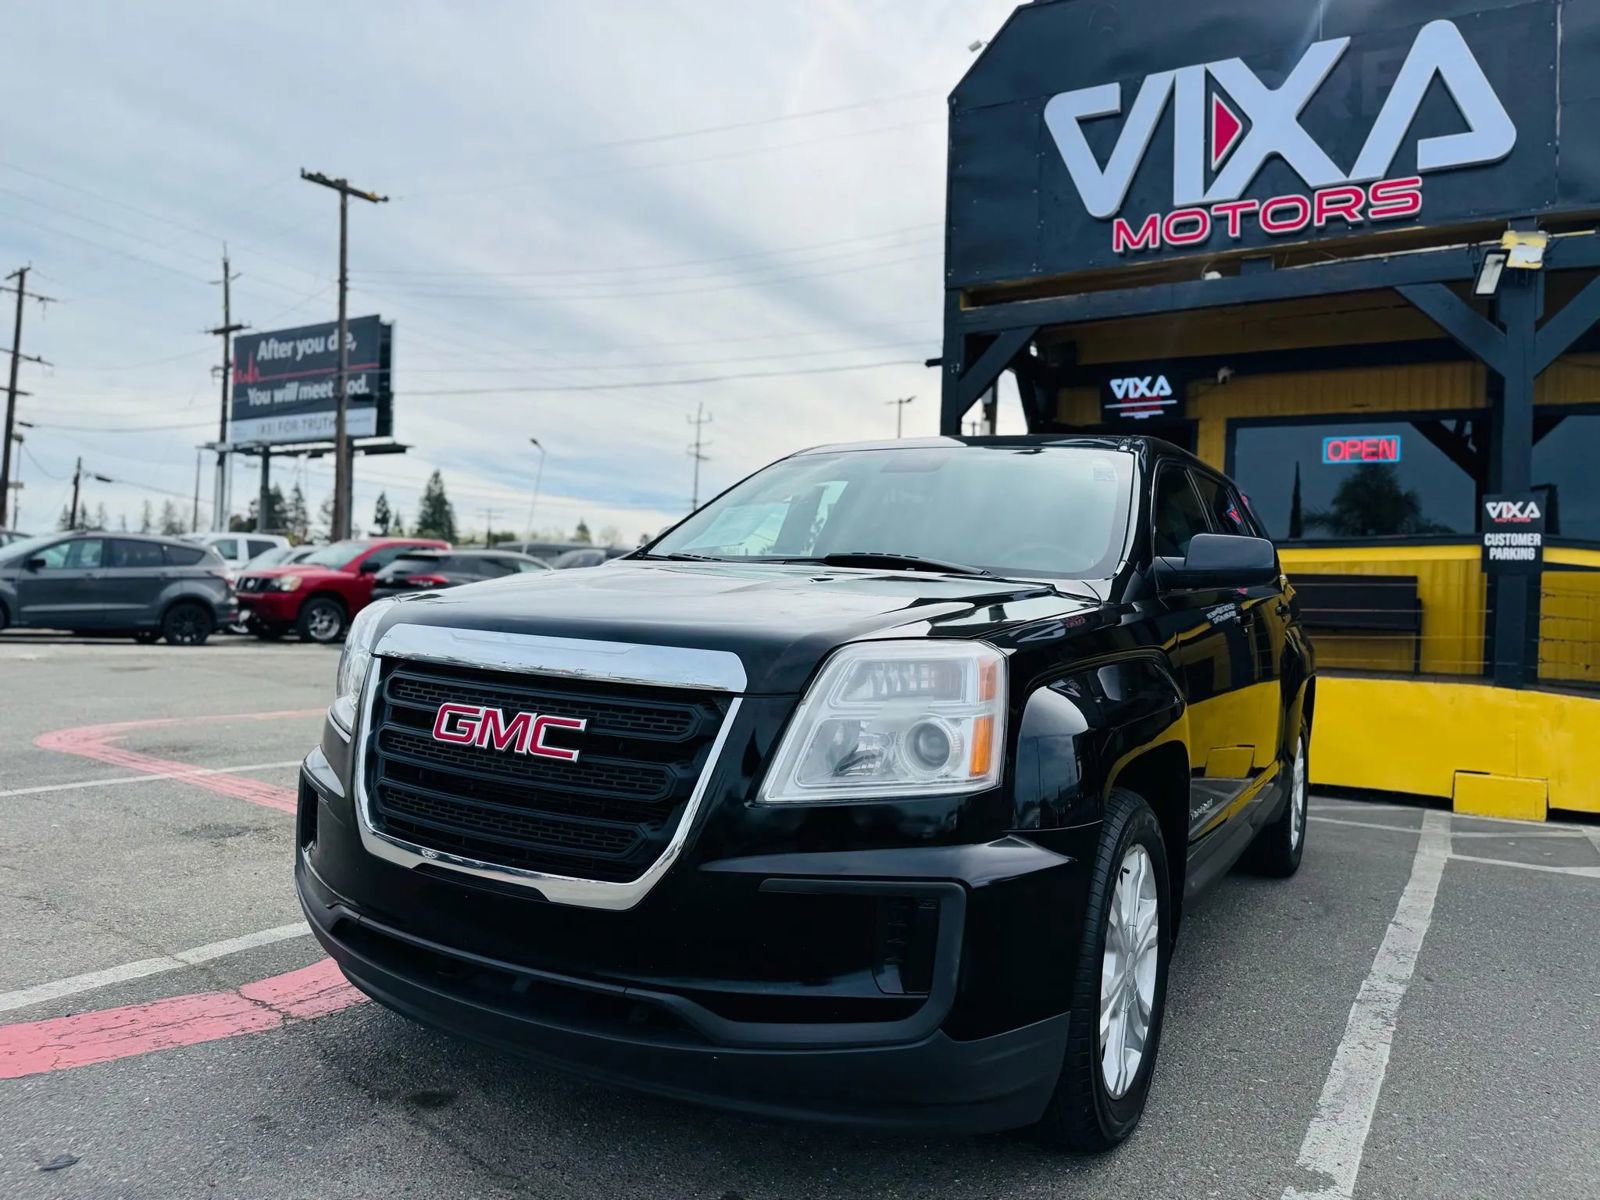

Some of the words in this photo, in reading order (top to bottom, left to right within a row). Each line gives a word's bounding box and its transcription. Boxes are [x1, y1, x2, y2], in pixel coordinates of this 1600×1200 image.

[1044, 19, 1517, 219] VIXA
[1112, 176, 1423, 254] MOTORS
[256, 337, 295, 362] After
[296, 335, 326, 362] you
[327, 328, 357, 352] de,
[247, 387, 271, 406] You
[273, 381, 299, 403] will
[299, 381, 334, 401] meet
[345, 373, 370, 395] od.
[1109, 374, 1173, 399] VIXA
[1327, 438, 1397, 461] OPEN
[1485, 501, 1541, 518] VIXA
[1484, 533, 1541, 547] CUSTOMER
[1489, 547, 1536, 561] PARKING
[432, 702, 587, 763] GMC
